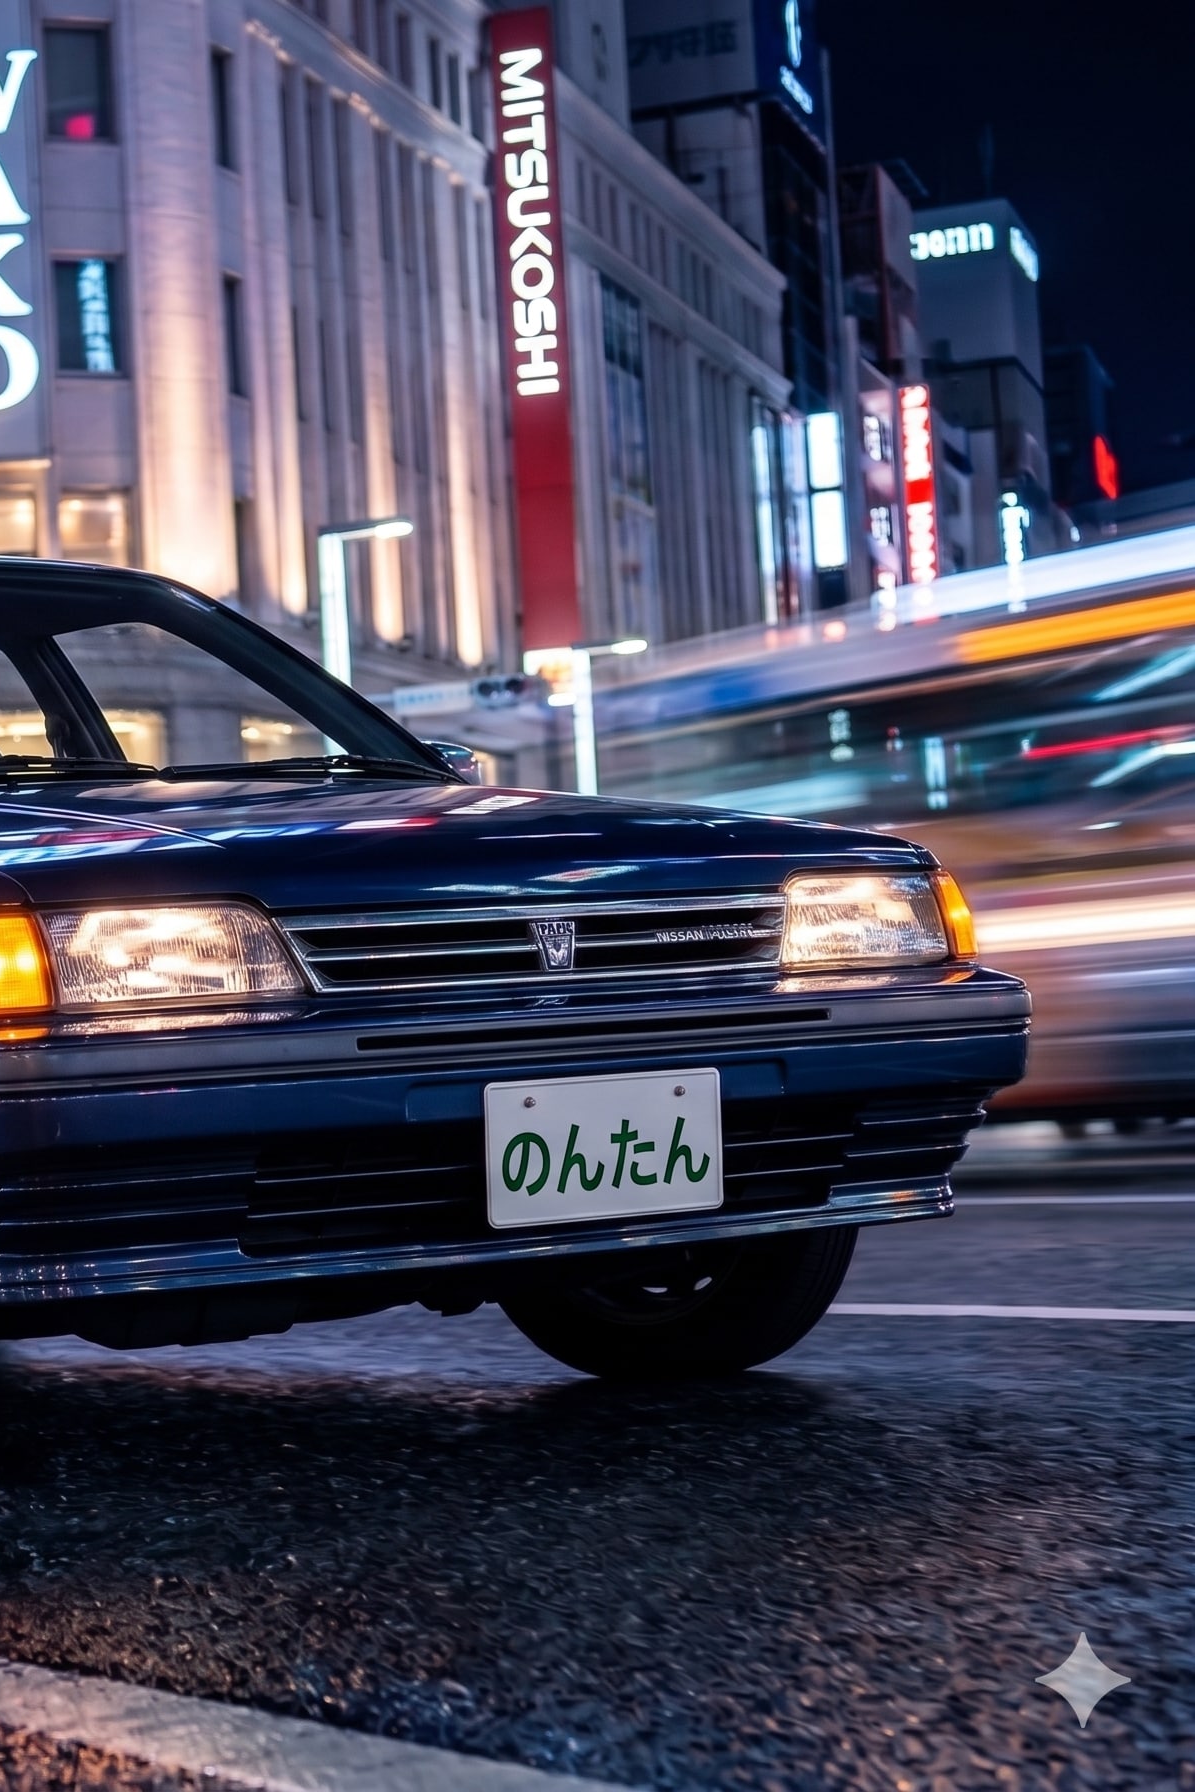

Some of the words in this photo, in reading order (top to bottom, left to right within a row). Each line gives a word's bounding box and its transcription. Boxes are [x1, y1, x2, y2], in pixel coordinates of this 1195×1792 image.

[499, 48, 560, 396] MITSUKOSHI
[656, 929, 704, 942] NISSAN
[502, 1116, 710, 1196] のんたん
